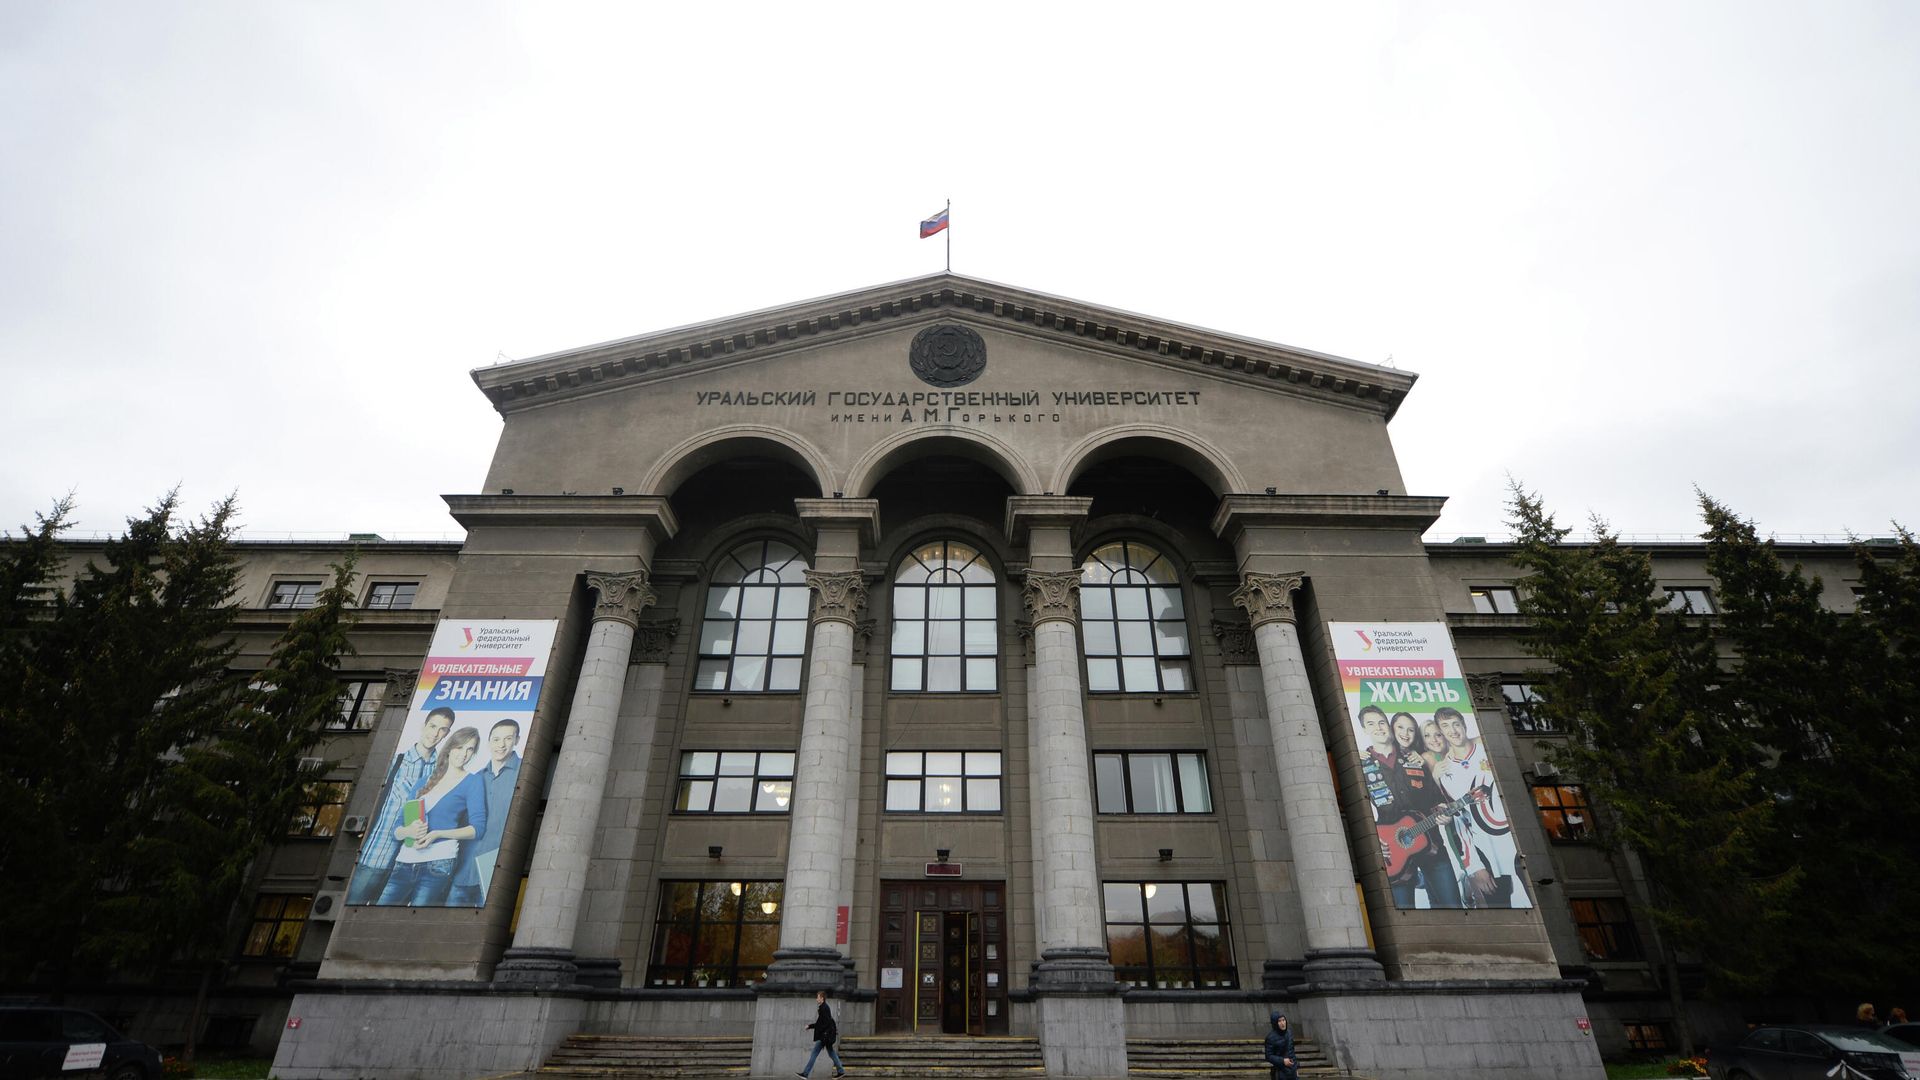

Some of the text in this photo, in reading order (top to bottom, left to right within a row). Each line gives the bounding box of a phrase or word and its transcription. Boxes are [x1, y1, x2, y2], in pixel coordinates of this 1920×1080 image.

[696, 390, 1201, 406] УРАЛЬСКИЙ ГОСУДАРСТВЕННЫЙ УНИВЕРСИТЕТ
[477, 634, 531, 643] федеральный
[1374, 637, 1428, 645] федеральный
[1376, 645, 1424, 653] университет
[431, 663, 523, 674] УВЛЕКАТЕЛЬНЫЕ
[1346, 666, 1436, 677] УВЛЕКАТЕЛЬНАЯ
[435, 680, 533, 701] ЗНАНИЯ
[1365, 681, 1460, 703] ЖИЗНЬ
